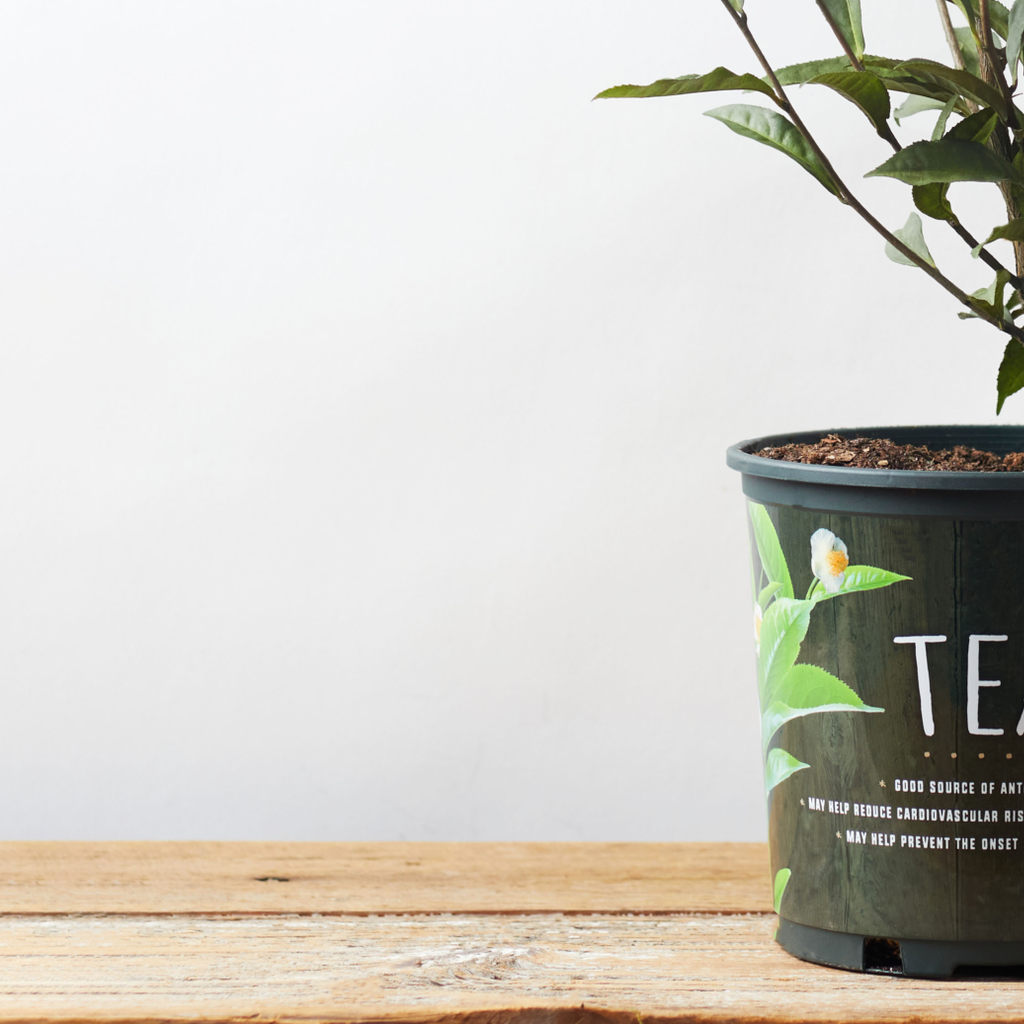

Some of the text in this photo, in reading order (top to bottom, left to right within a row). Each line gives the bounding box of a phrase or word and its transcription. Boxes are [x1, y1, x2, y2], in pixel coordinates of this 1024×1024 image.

[894, 779, 925, 793] GOOD
[929, 781, 976, 795] SOURCE
[980, 782, 995, 795] OF
[808, 796, 826, 812] MAY
[828, 800, 850, 815] HELP
[853, 803, 892, 819] REDUCE
[896, 807, 999, 823] CARDIOVASCULAR
[846, 829, 867, 845] MAY
[871, 833, 896, 847] HELP
[900, 834, 951, 849] PREVENT
[954, 837, 977, 850] THE
[981, 837, 1019, 851] ONSET
